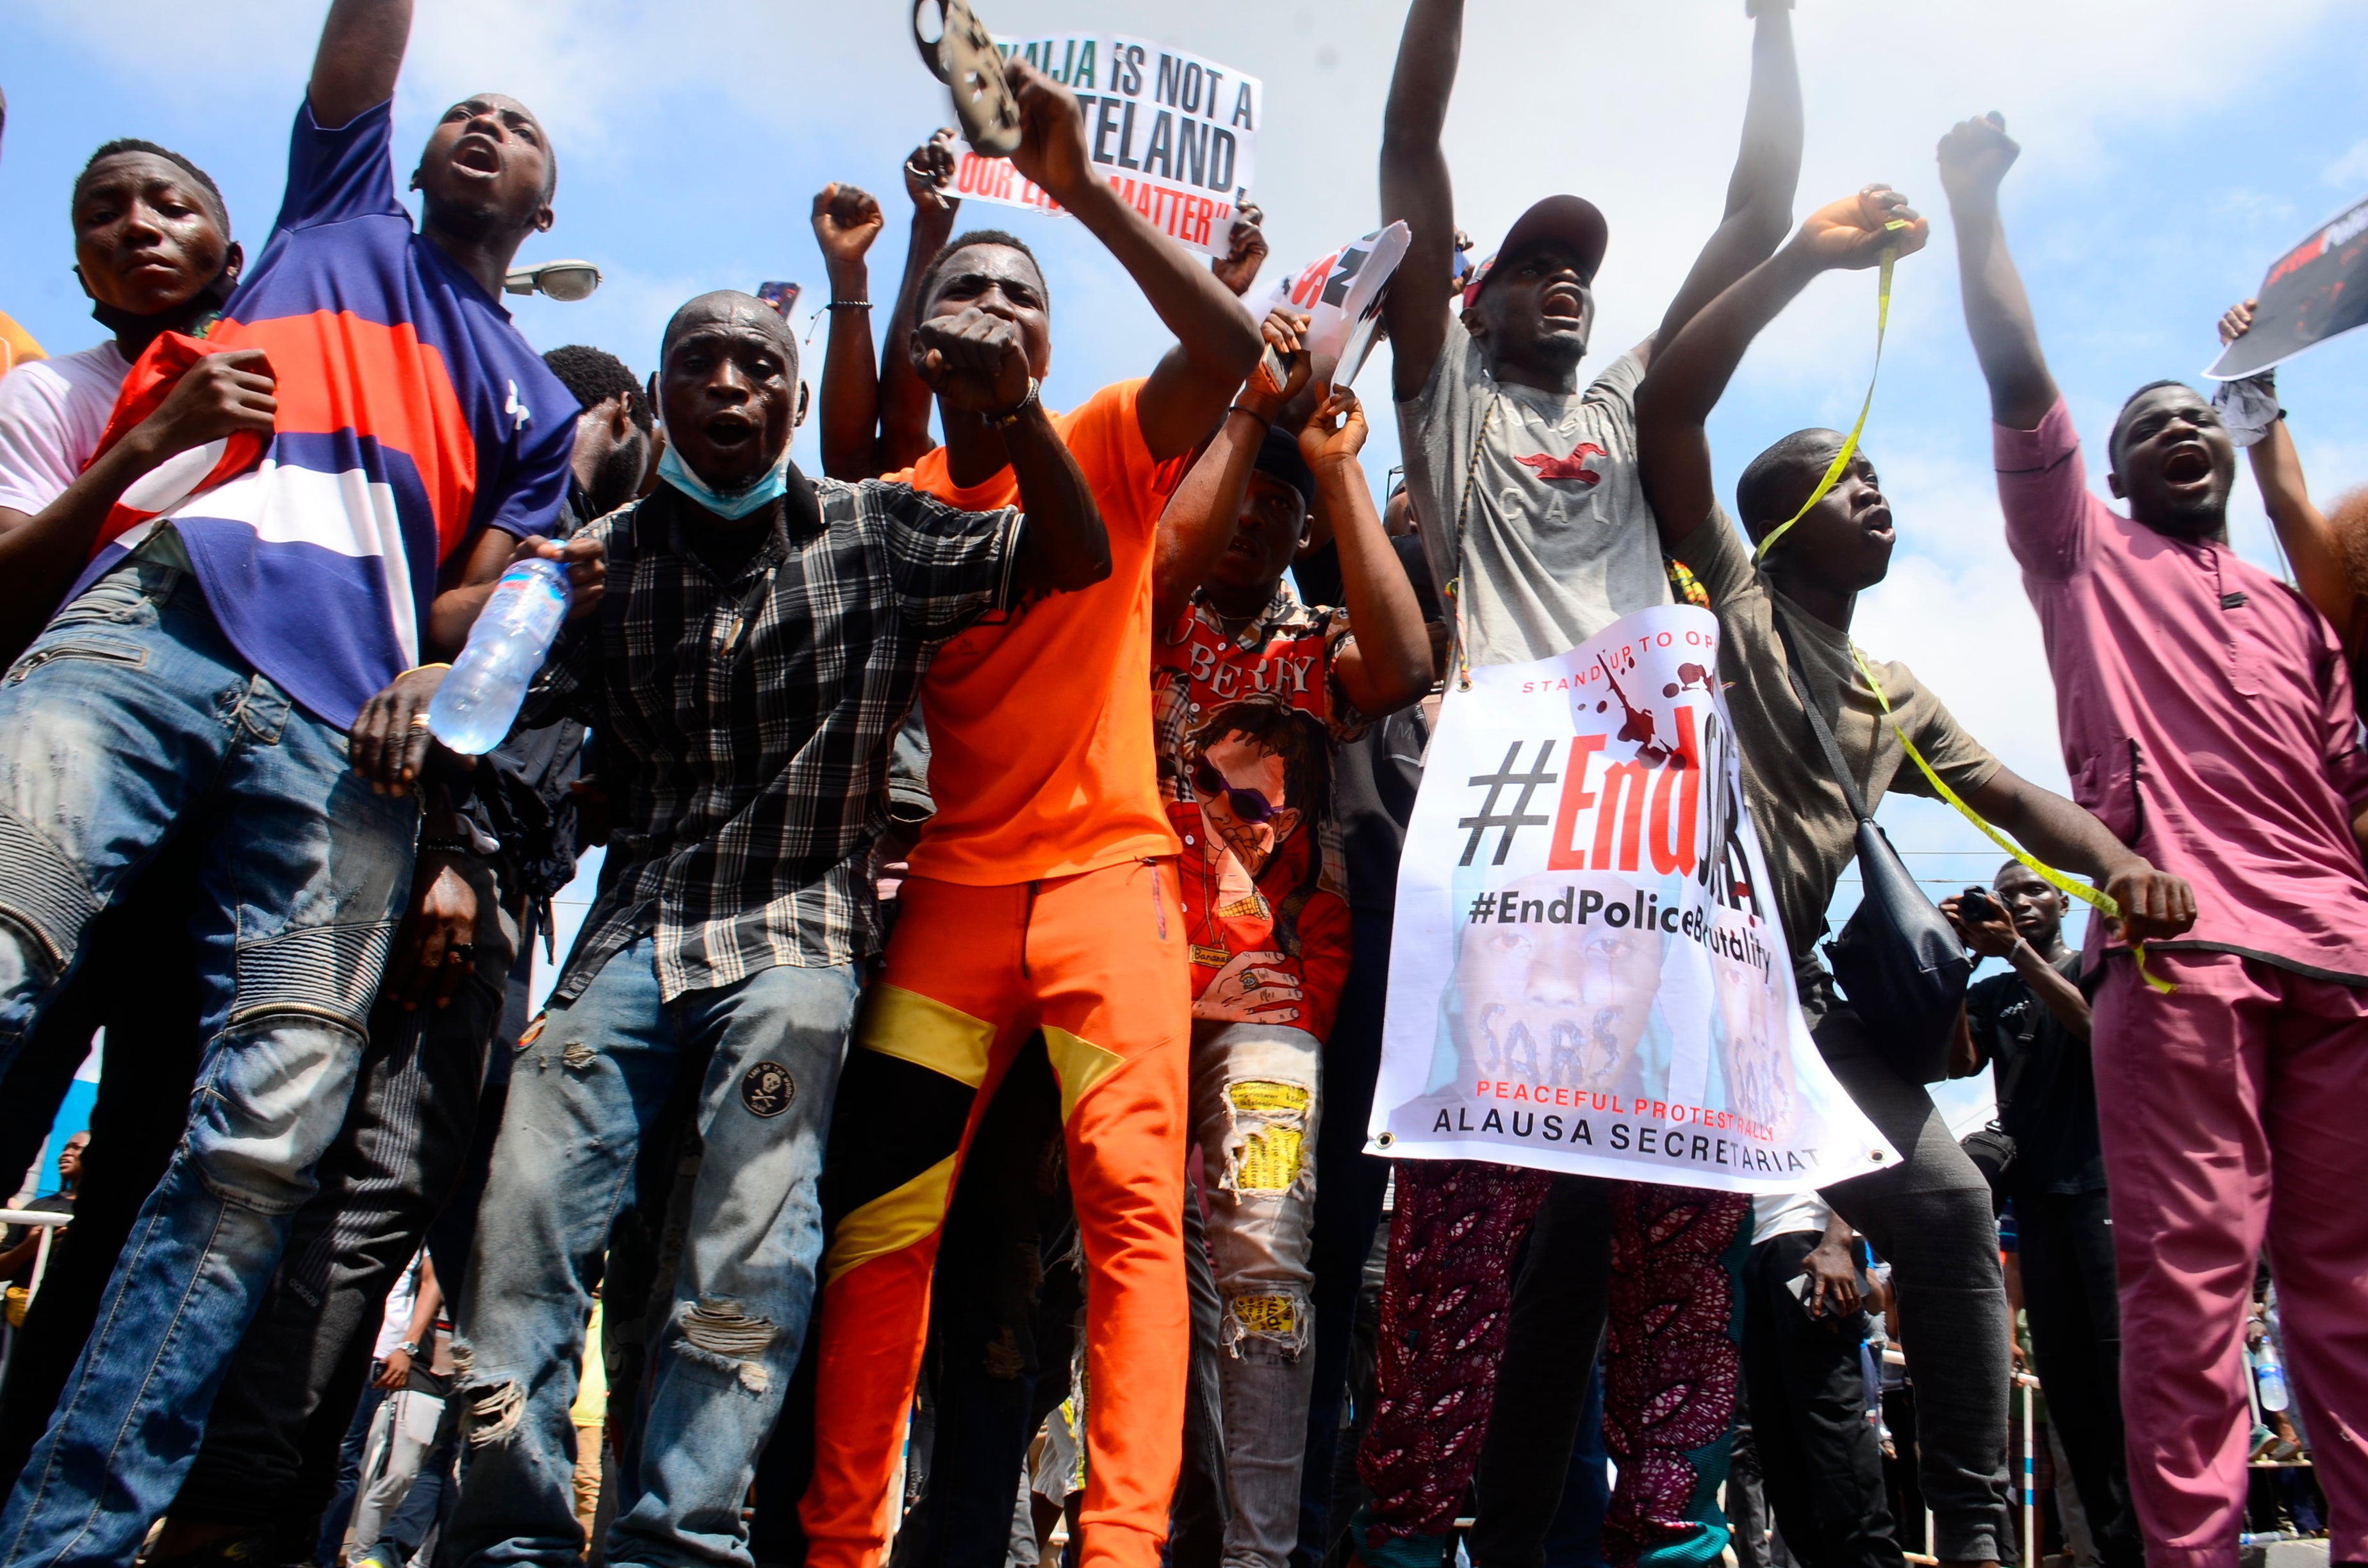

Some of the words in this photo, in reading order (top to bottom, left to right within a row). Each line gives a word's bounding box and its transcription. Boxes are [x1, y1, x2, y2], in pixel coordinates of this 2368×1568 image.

[998, 40, 1096, 88] IJA
[1111, 42, 1146, 97] IS
[1156, 53, 1222, 120] NOT
[1233, 83, 1253, 131] A
[958, 152, 1019, 200] OUR
[1075, 94, 1247, 209] TELAND,
[1522, 667, 1601, 694] STAND
[1608, 646, 1633, 675] UP
[1638, 632, 1672, 652] TO
[1686, 630, 1718, 649] OP
[1469, 886, 1772, 984] #EndPoliceBrutality
[1433, 1109, 1593, 1145] ALAUSA
[1610, 1123, 1821, 1173] SECRETARIAT
[1476, 1080, 1624, 1114] PEACEFUL
[1634, 1098, 1733, 1131] PROTEST
[1736, 1116, 1774, 1142] RALLY
